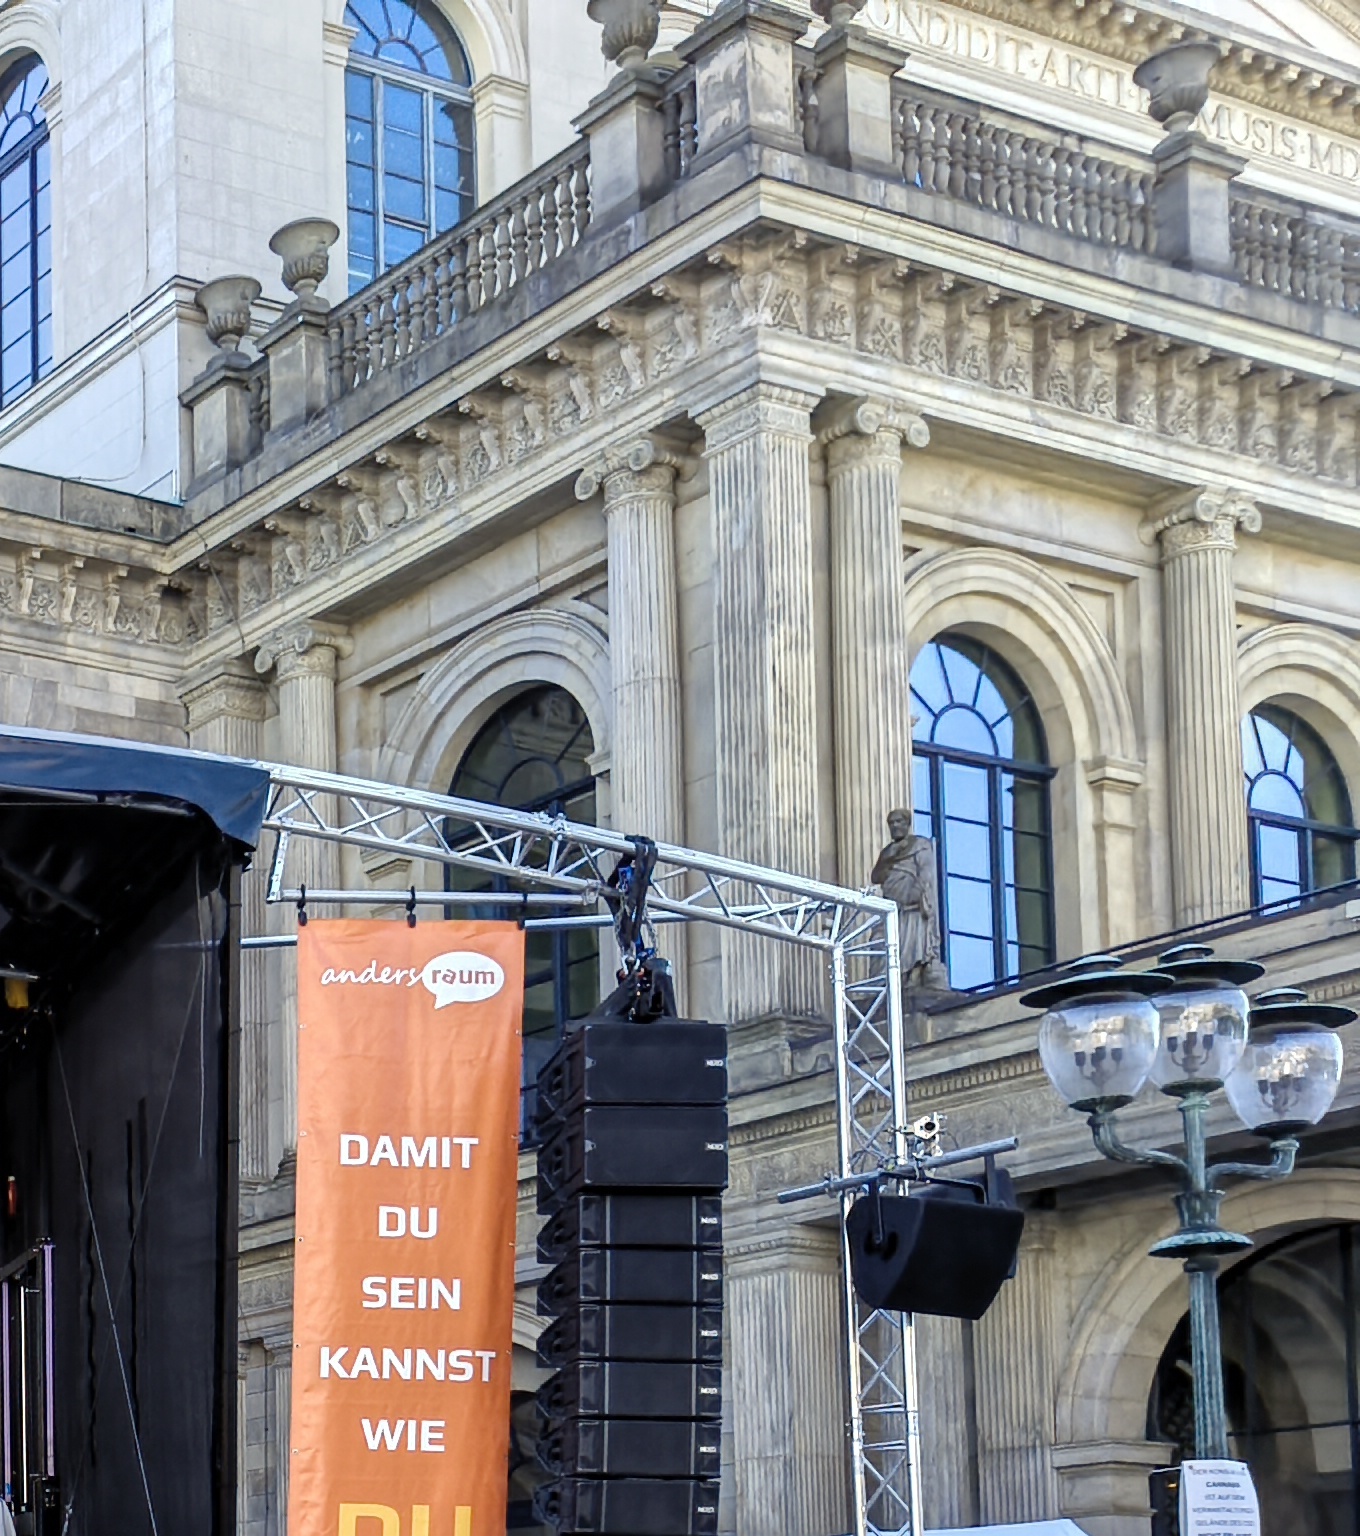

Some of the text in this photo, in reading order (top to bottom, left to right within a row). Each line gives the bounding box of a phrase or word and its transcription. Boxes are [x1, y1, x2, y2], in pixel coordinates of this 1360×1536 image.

[339, 1133, 480, 1169] DAMIT
[378, 1205, 439, 1239] DU
[362, 1276, 462, 1311] SEIN
[319, 1346, 498, 1383] KANNST
[361, 1418, 446, 1453] WIE
